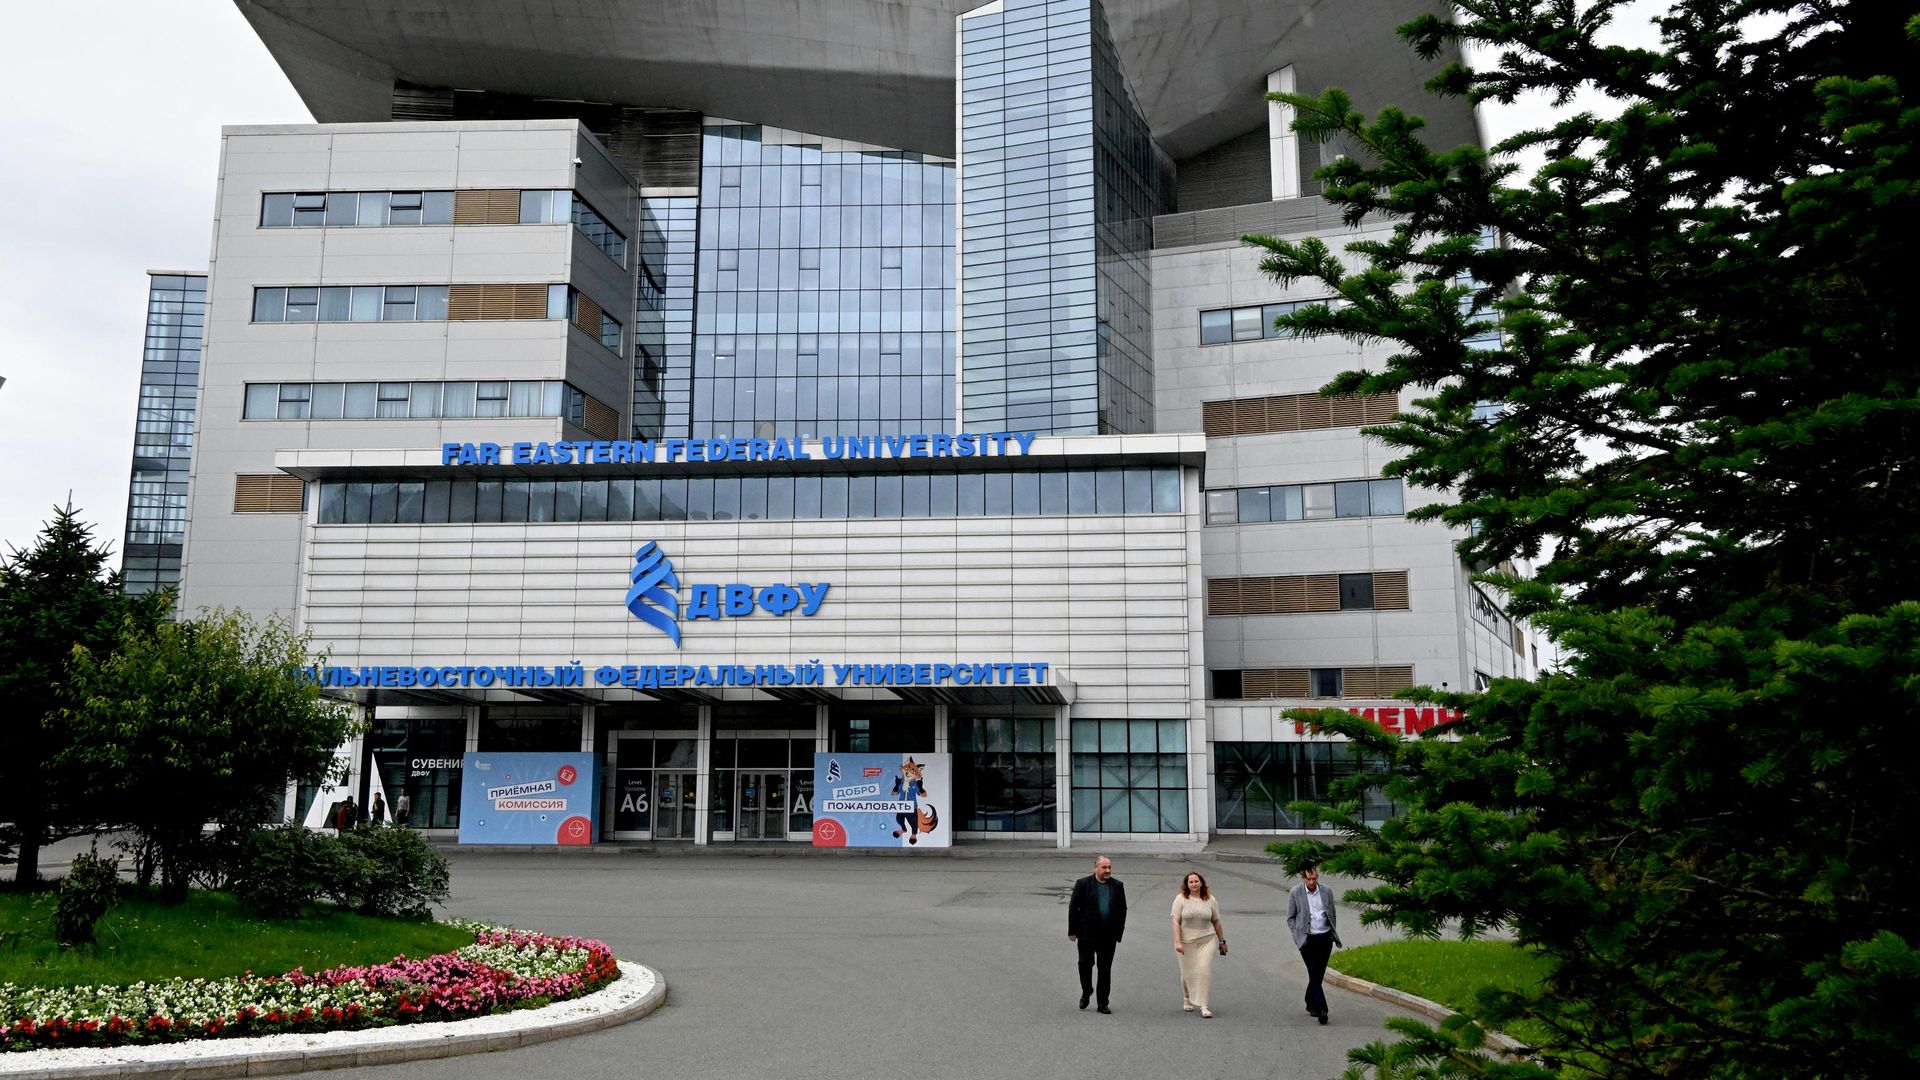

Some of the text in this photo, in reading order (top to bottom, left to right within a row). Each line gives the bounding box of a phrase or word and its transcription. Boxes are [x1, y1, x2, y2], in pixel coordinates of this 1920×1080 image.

[442, 432, 1036, 465] FAR EASTERN FEDERAL UNIVERSITY
[686, 582, 831, 620] ДВФУ
[291, 659, 1049, 690] ЛЬНЕВОСТОЧНЫЙ ФЕДЕРАЛЬНЫЙ УНИВЕРСИТЕТ
[490, 782, 552, 799] ПРИЁМНАЯ
[836, 785, 876, 799] ДОБРО
[498, 801, 564, 809] КОМИССИЯ
[620, 793, 649, 813] A6
[827, 802, 912, 811] ПОЖАЛОВАТЬ
